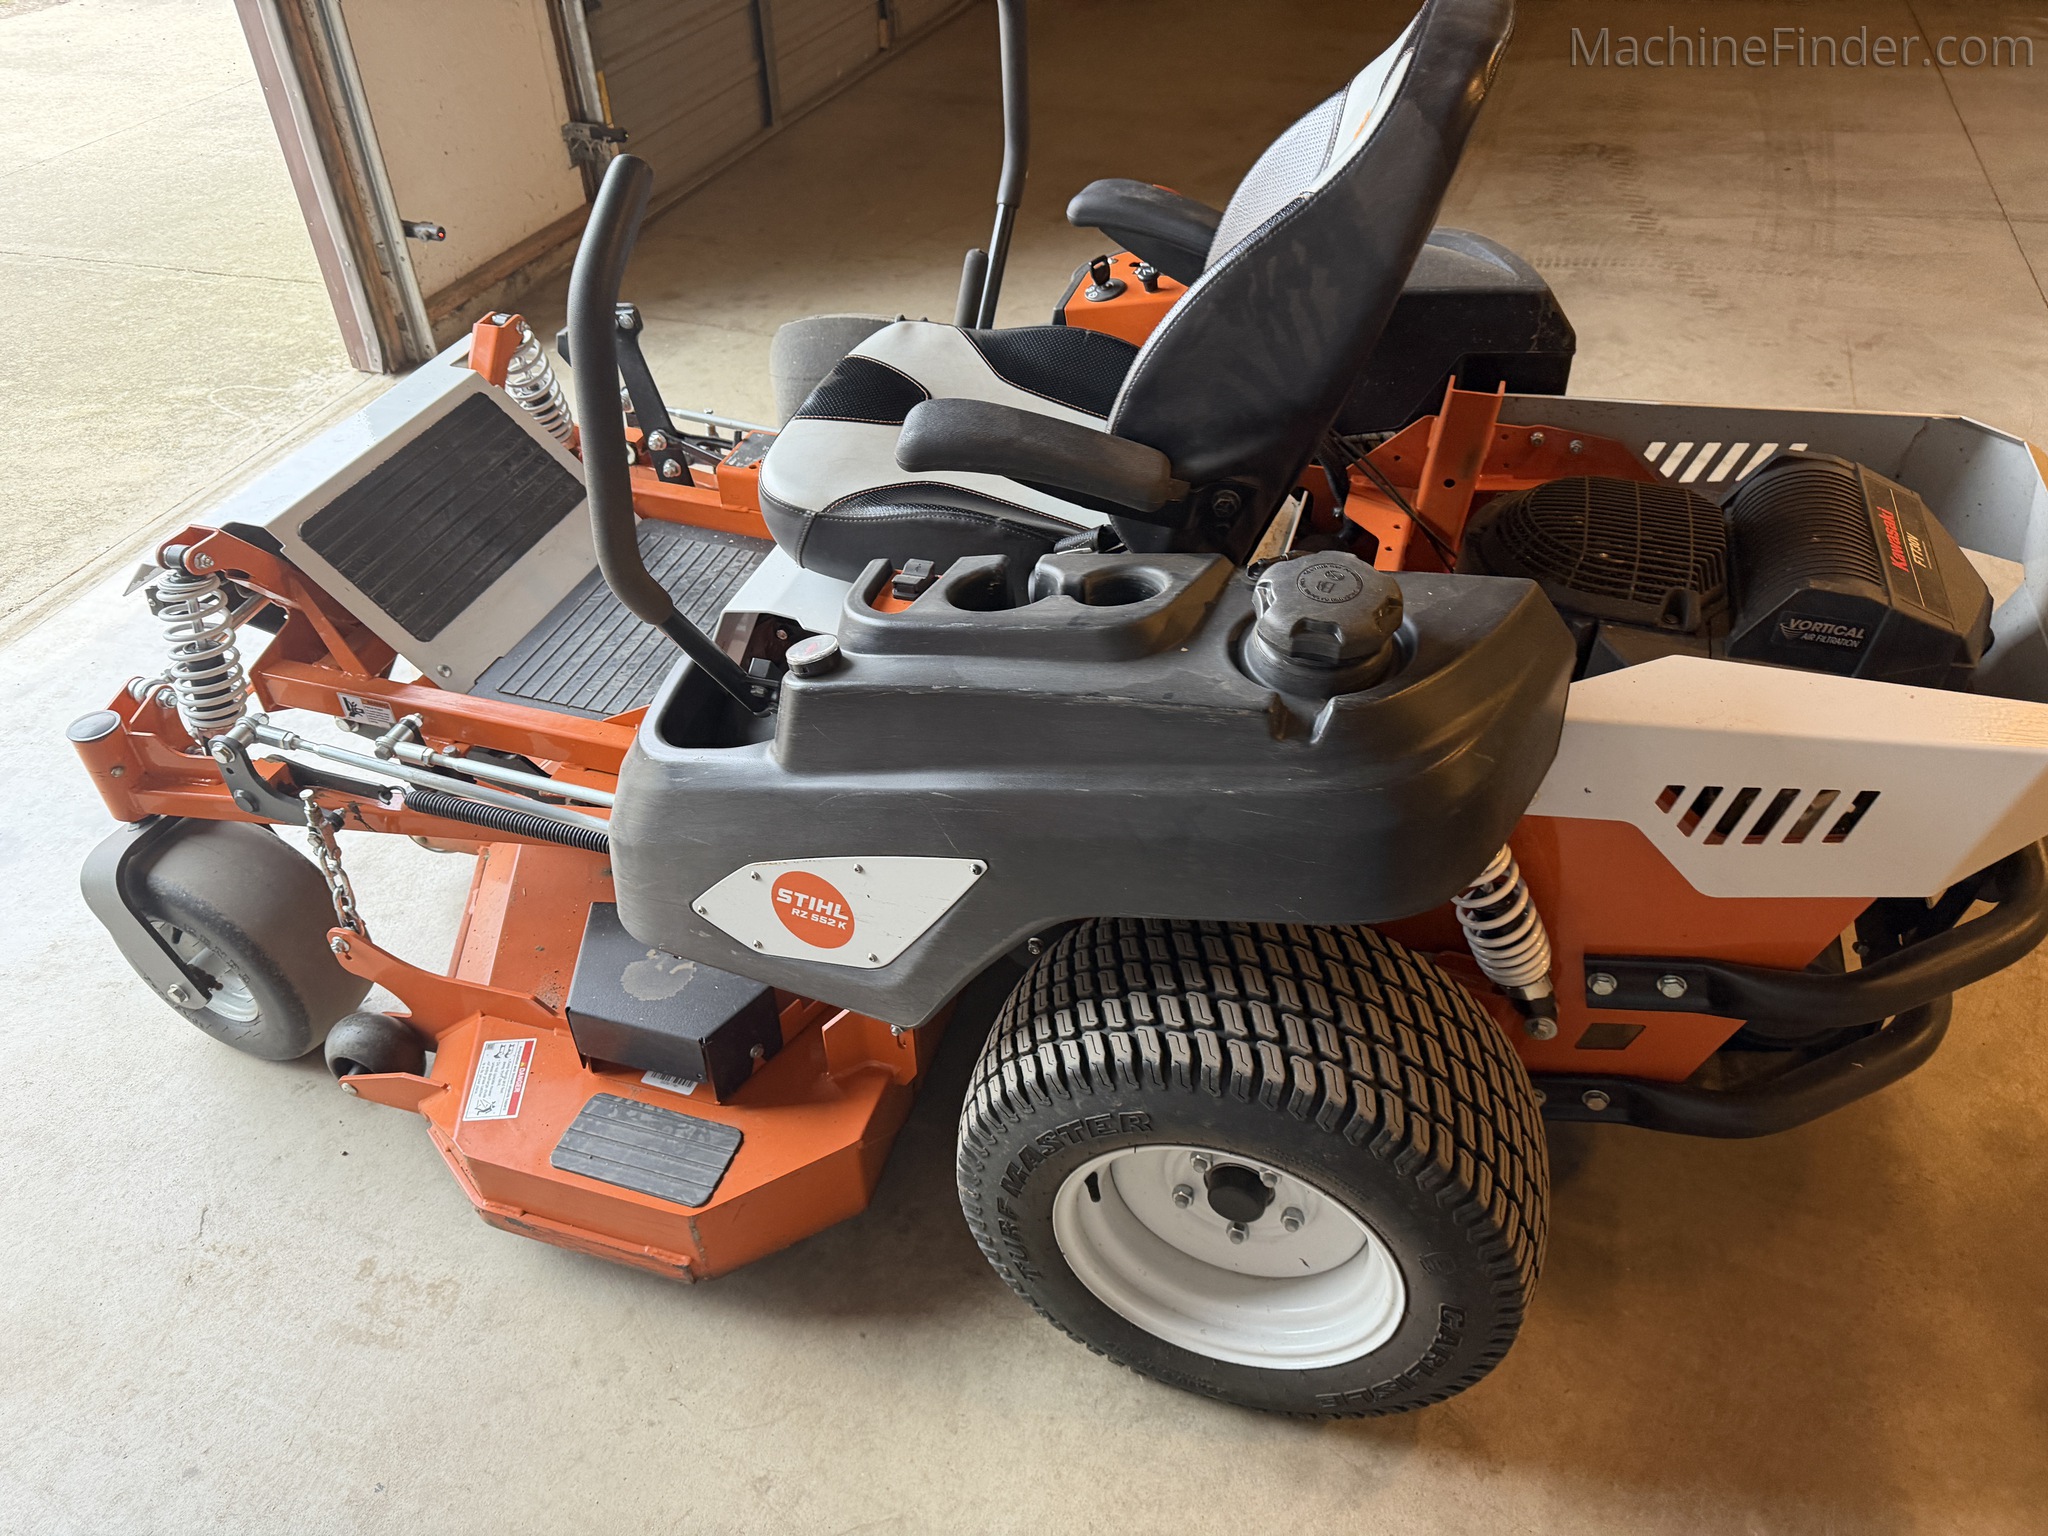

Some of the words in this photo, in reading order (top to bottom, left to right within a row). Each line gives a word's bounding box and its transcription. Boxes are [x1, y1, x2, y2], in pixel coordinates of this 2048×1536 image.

[1876, 505, 1910, 573] Kawasaki
[1789, 618, 1865, 639] VORTICAL
[1801, 632, 1817, 642] AIR
[1816, 634, 1861, 648] FILTRATION
[776, 887, 849, 921] STIHL
[791, 908, 808, 919] RZ
[811, 913, 836, 927] 552
[837, 921, 847, 930] K
[513, 1067, 526, 1093] DANGER
[1000, 1110, 1153, 1199] MASTER
[996, 1196, 1042, 1283] TURF
[1315, 1302, 1466, 1410] CARLISLE
